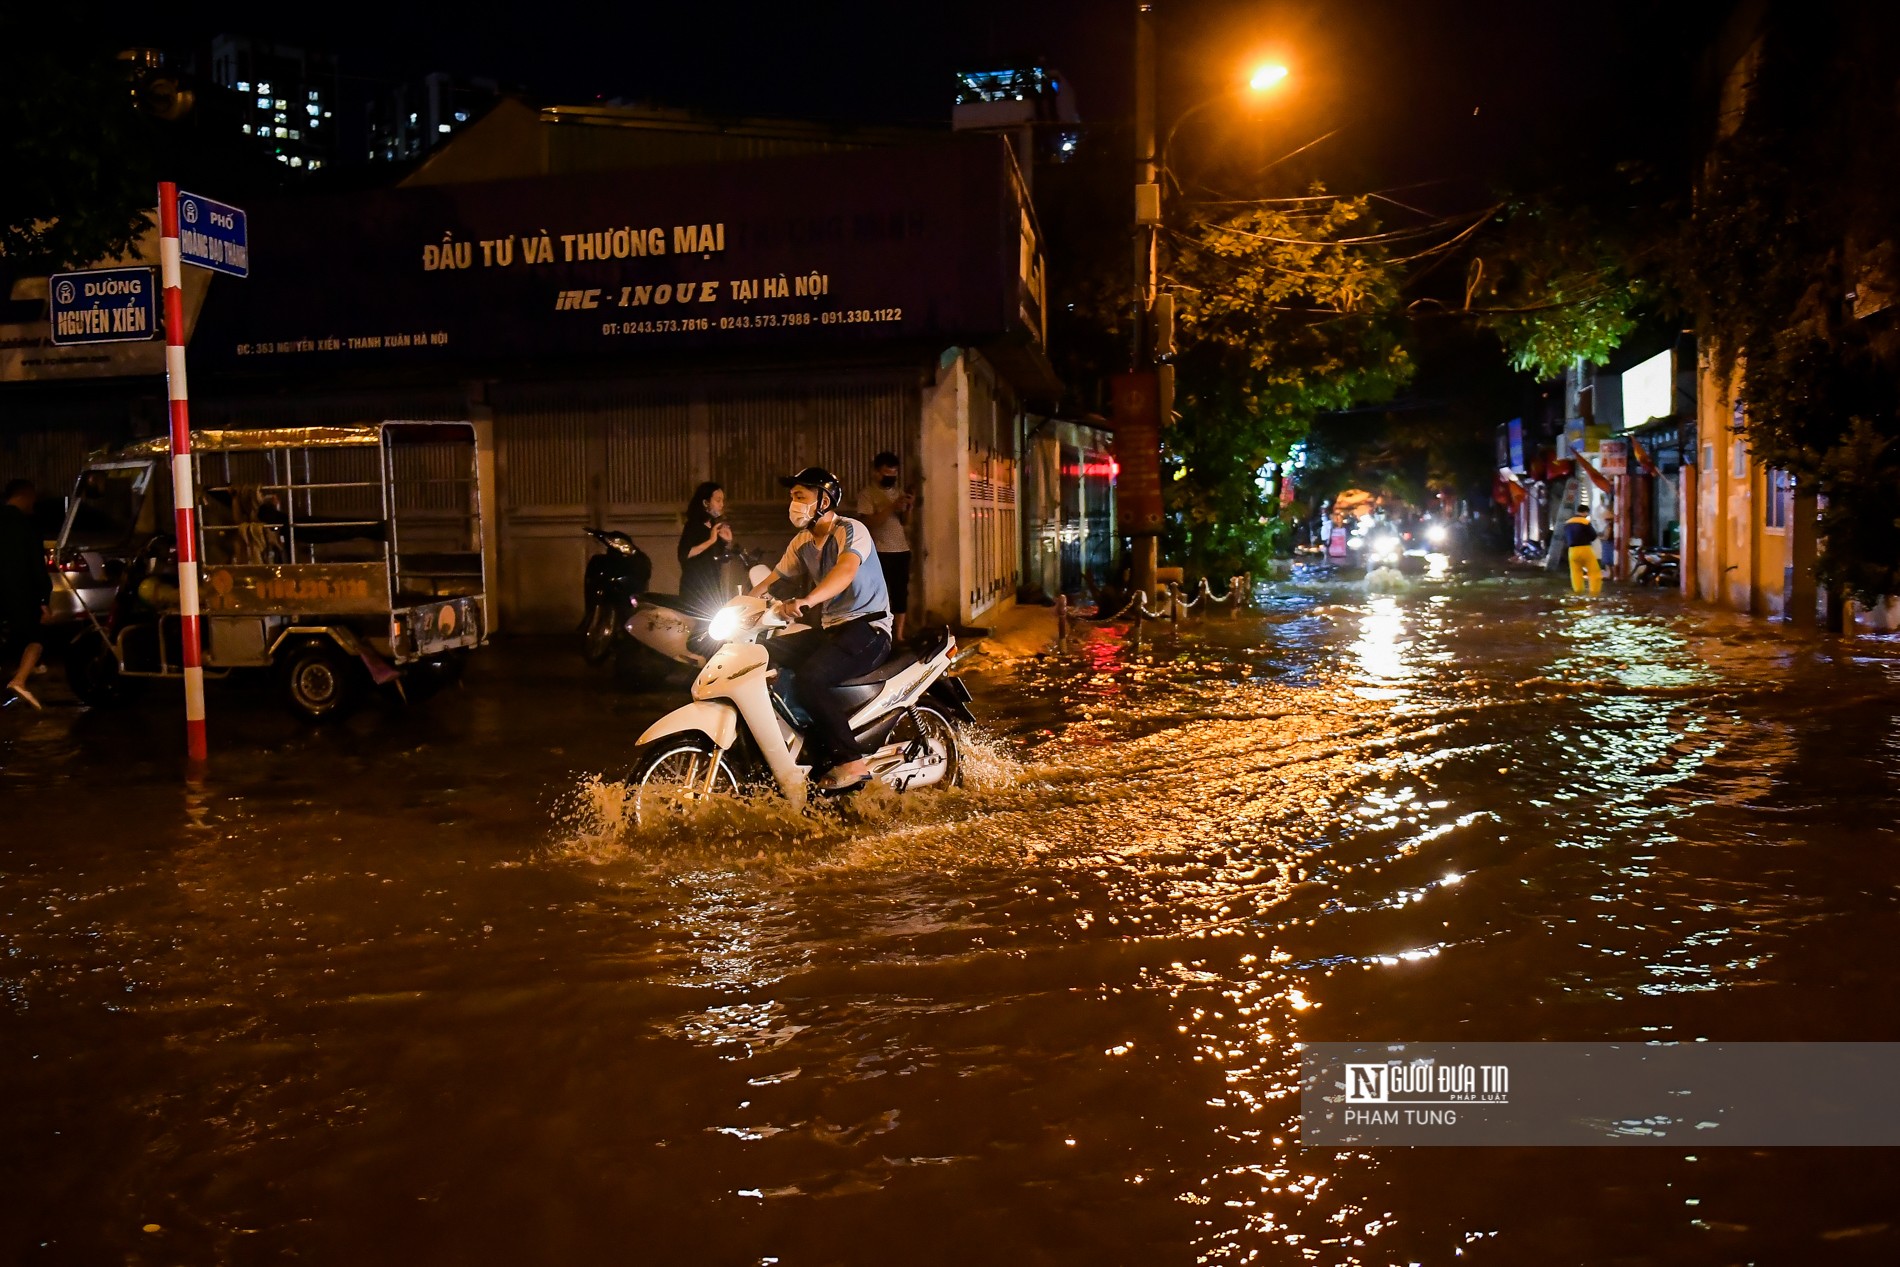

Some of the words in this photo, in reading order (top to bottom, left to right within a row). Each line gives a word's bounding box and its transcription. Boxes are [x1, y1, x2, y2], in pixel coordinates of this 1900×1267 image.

[210, 212, 234, 230] PHỐ
[423, 230, 472, 271] ĐẦU
[480, 234, 515, 267] TƯ
[521, 228, 554, 264] VÀ
[560, 227, 666, 262] THƯƠNG
[673, 223, 725, 260] MẠI
[617, 281, 720, 307] INOUE
[730, 279, 758, 304] TẠI
[763, 273, 789, 299] HÀ
[795, 270, 828, 301] NỘI
[57, 301, 110, 336] NGUYỄN
[112, 297, 146, 333] XIỂN
[622, 317, 709, 333] 0243.573.7816
[720, 312, 811, 330] 0243.573.7988
[821, 308, 902, 325] 091.330.1122
[348, 336, 382, 350] THANH
[413, 331, 428, 346] HÀ
[430, 330, 449, 347] NỘI
